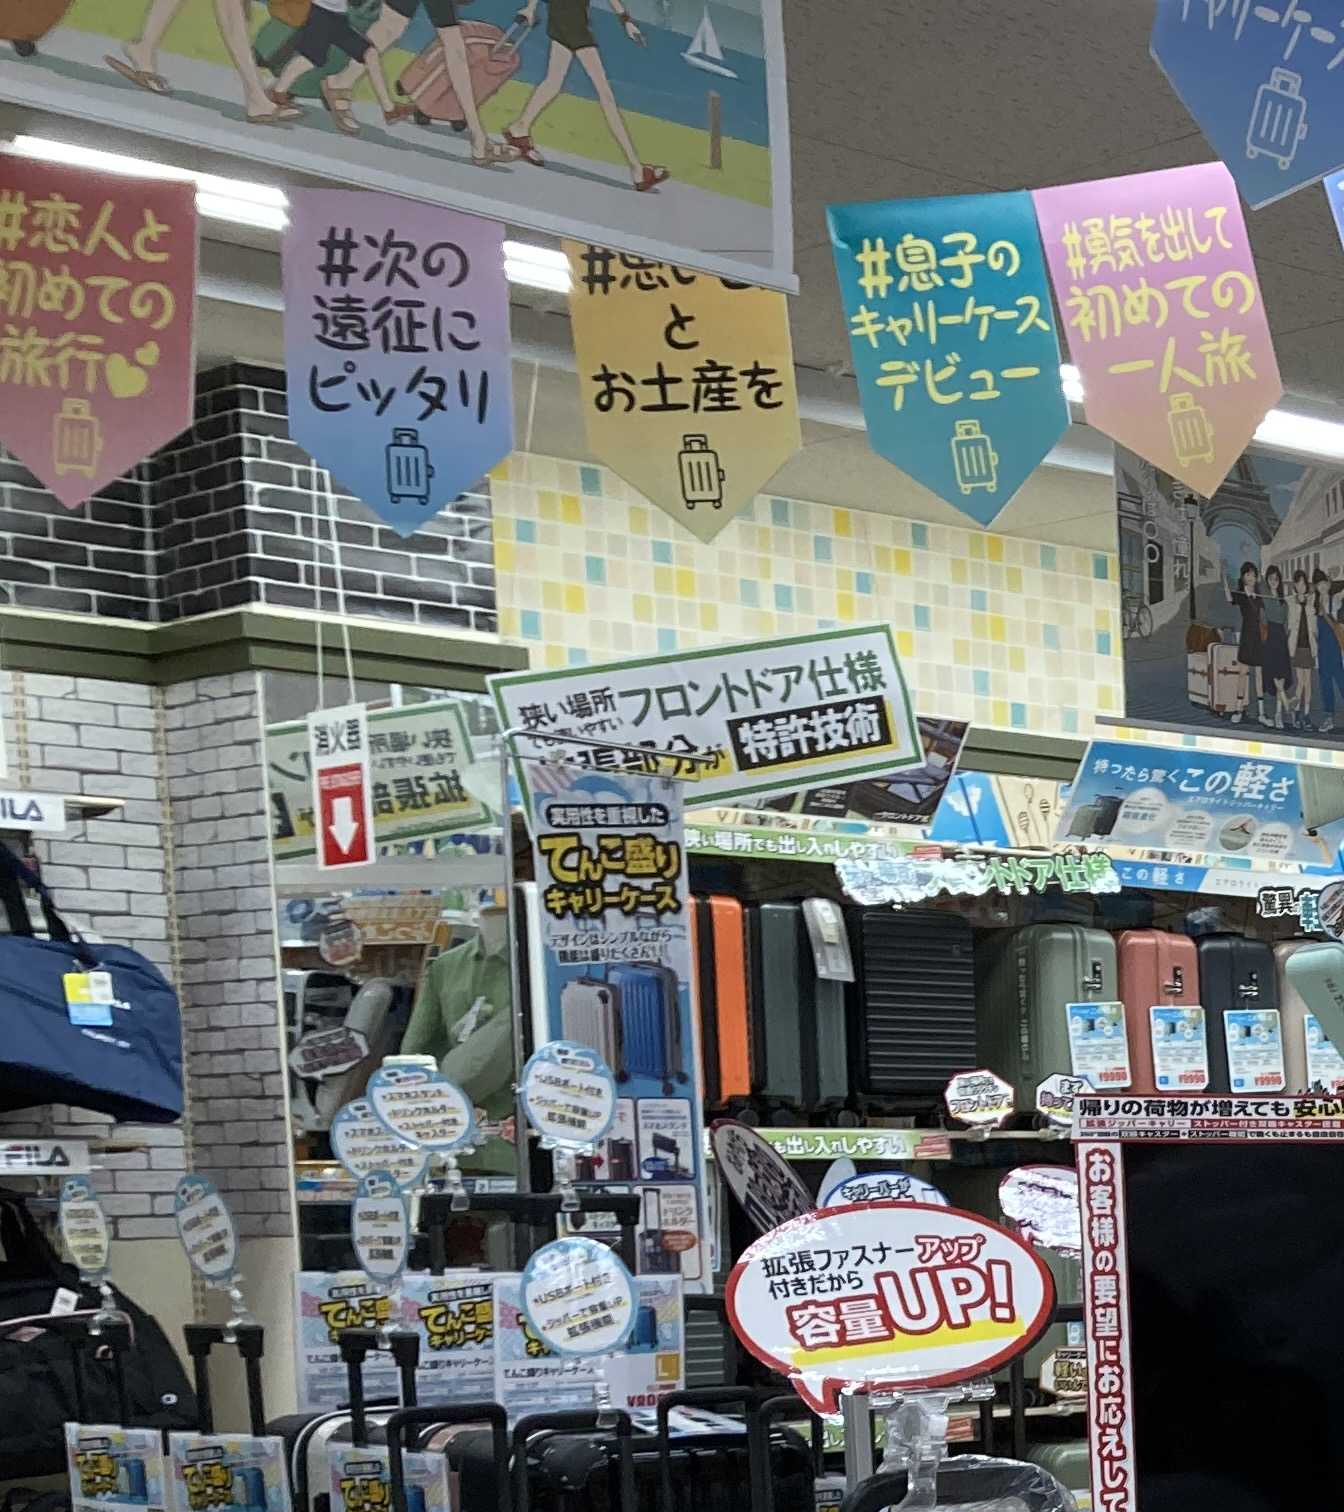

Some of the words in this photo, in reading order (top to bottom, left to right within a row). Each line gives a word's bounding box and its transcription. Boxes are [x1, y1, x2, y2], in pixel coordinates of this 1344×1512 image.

[319, 228, 470, 290] #次の
[856, 232, 1021, 297] #息子の
[1063, 205, 1232, 277] #勇気を出して
[851, 295, 1050, 349] キャリーケース
[1068, 255, 1257, 336] 初めての
[313, 296, 482, 352] 遠征に
[664, 303, 699, 350] と
[592, 359, 783, 414] お土産を
[874, 359, 1041, 411] デビュー
[1109, 329, 1259, 394] 一人旅
[309, 371, 489, 423] ピッタリ
[619, 649, 887, 727] フロントドア仕様
[739, 701, 880, 763] 特許技術
[538, 833, 680, 882] てんこ盛り
[546, 882, 677, 916] キャリーケース
[768, 1271, 864, 1298] 付きだから
[791, 1261, 1014, 1350] 容量UP!
